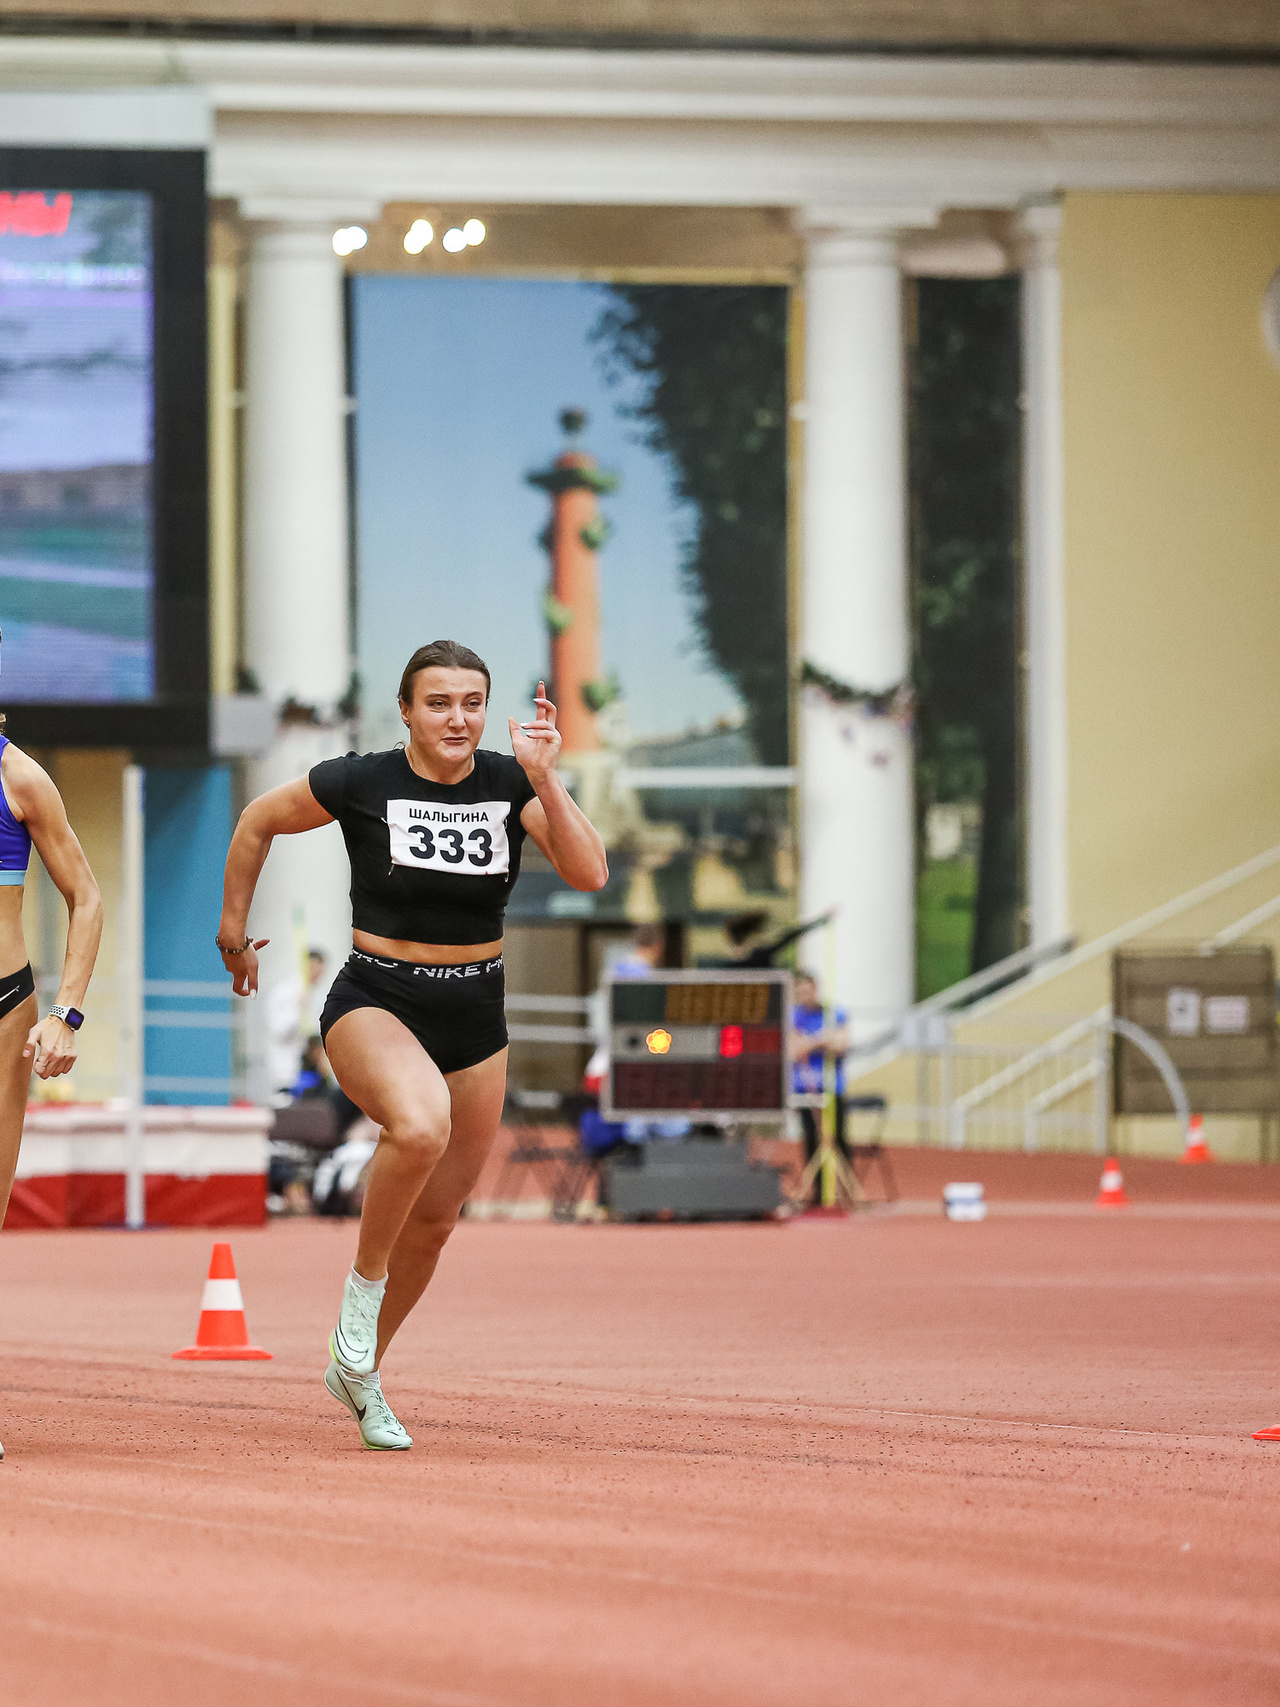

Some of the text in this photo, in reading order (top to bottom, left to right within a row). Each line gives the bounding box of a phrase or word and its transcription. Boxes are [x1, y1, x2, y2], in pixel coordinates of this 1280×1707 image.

[408, 807, 490, 823] ШАЛЫГИНА
[408, 825, 493, 867] 333
[413, 963, 482, 979] NIKE
